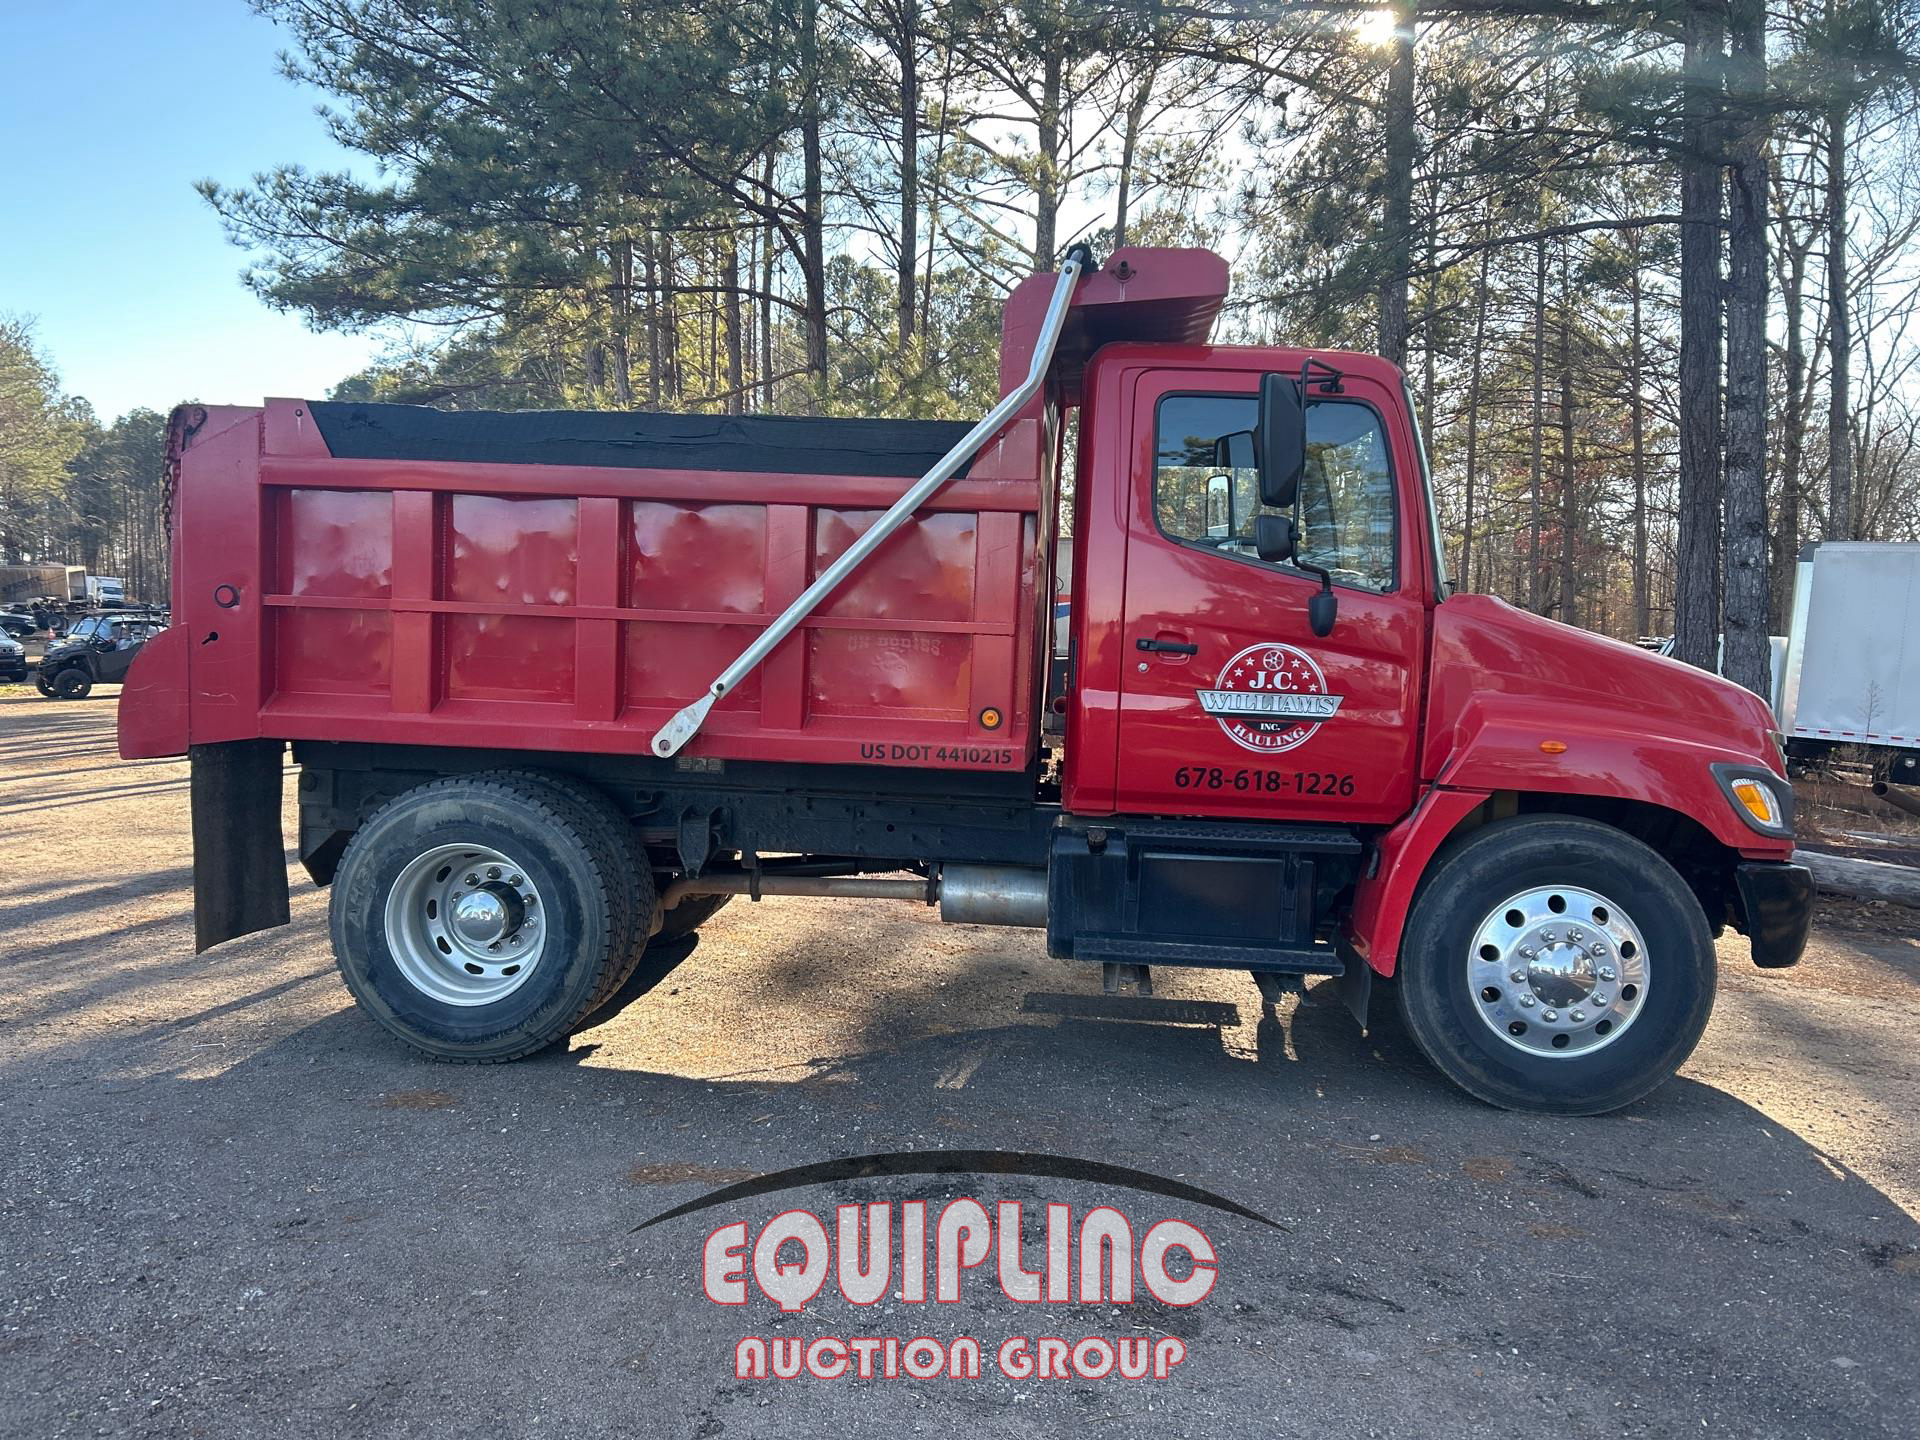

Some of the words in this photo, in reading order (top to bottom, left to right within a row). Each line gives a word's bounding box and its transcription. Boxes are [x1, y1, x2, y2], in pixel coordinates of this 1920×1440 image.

[1248, 671, 1299, 691] J.C.
[1202, 691, 1337, 715] WILLIAMS
[1232, 723, 1306, 747] HAULING
[1260, 722, 1281, 732] INC.
[860, 743, 886, 760] US
[891, 744, 932, 762] DOT
[936, 746, 1013, 765] 4410215
[1174, 766, 1355, 797] 678-618-1226
